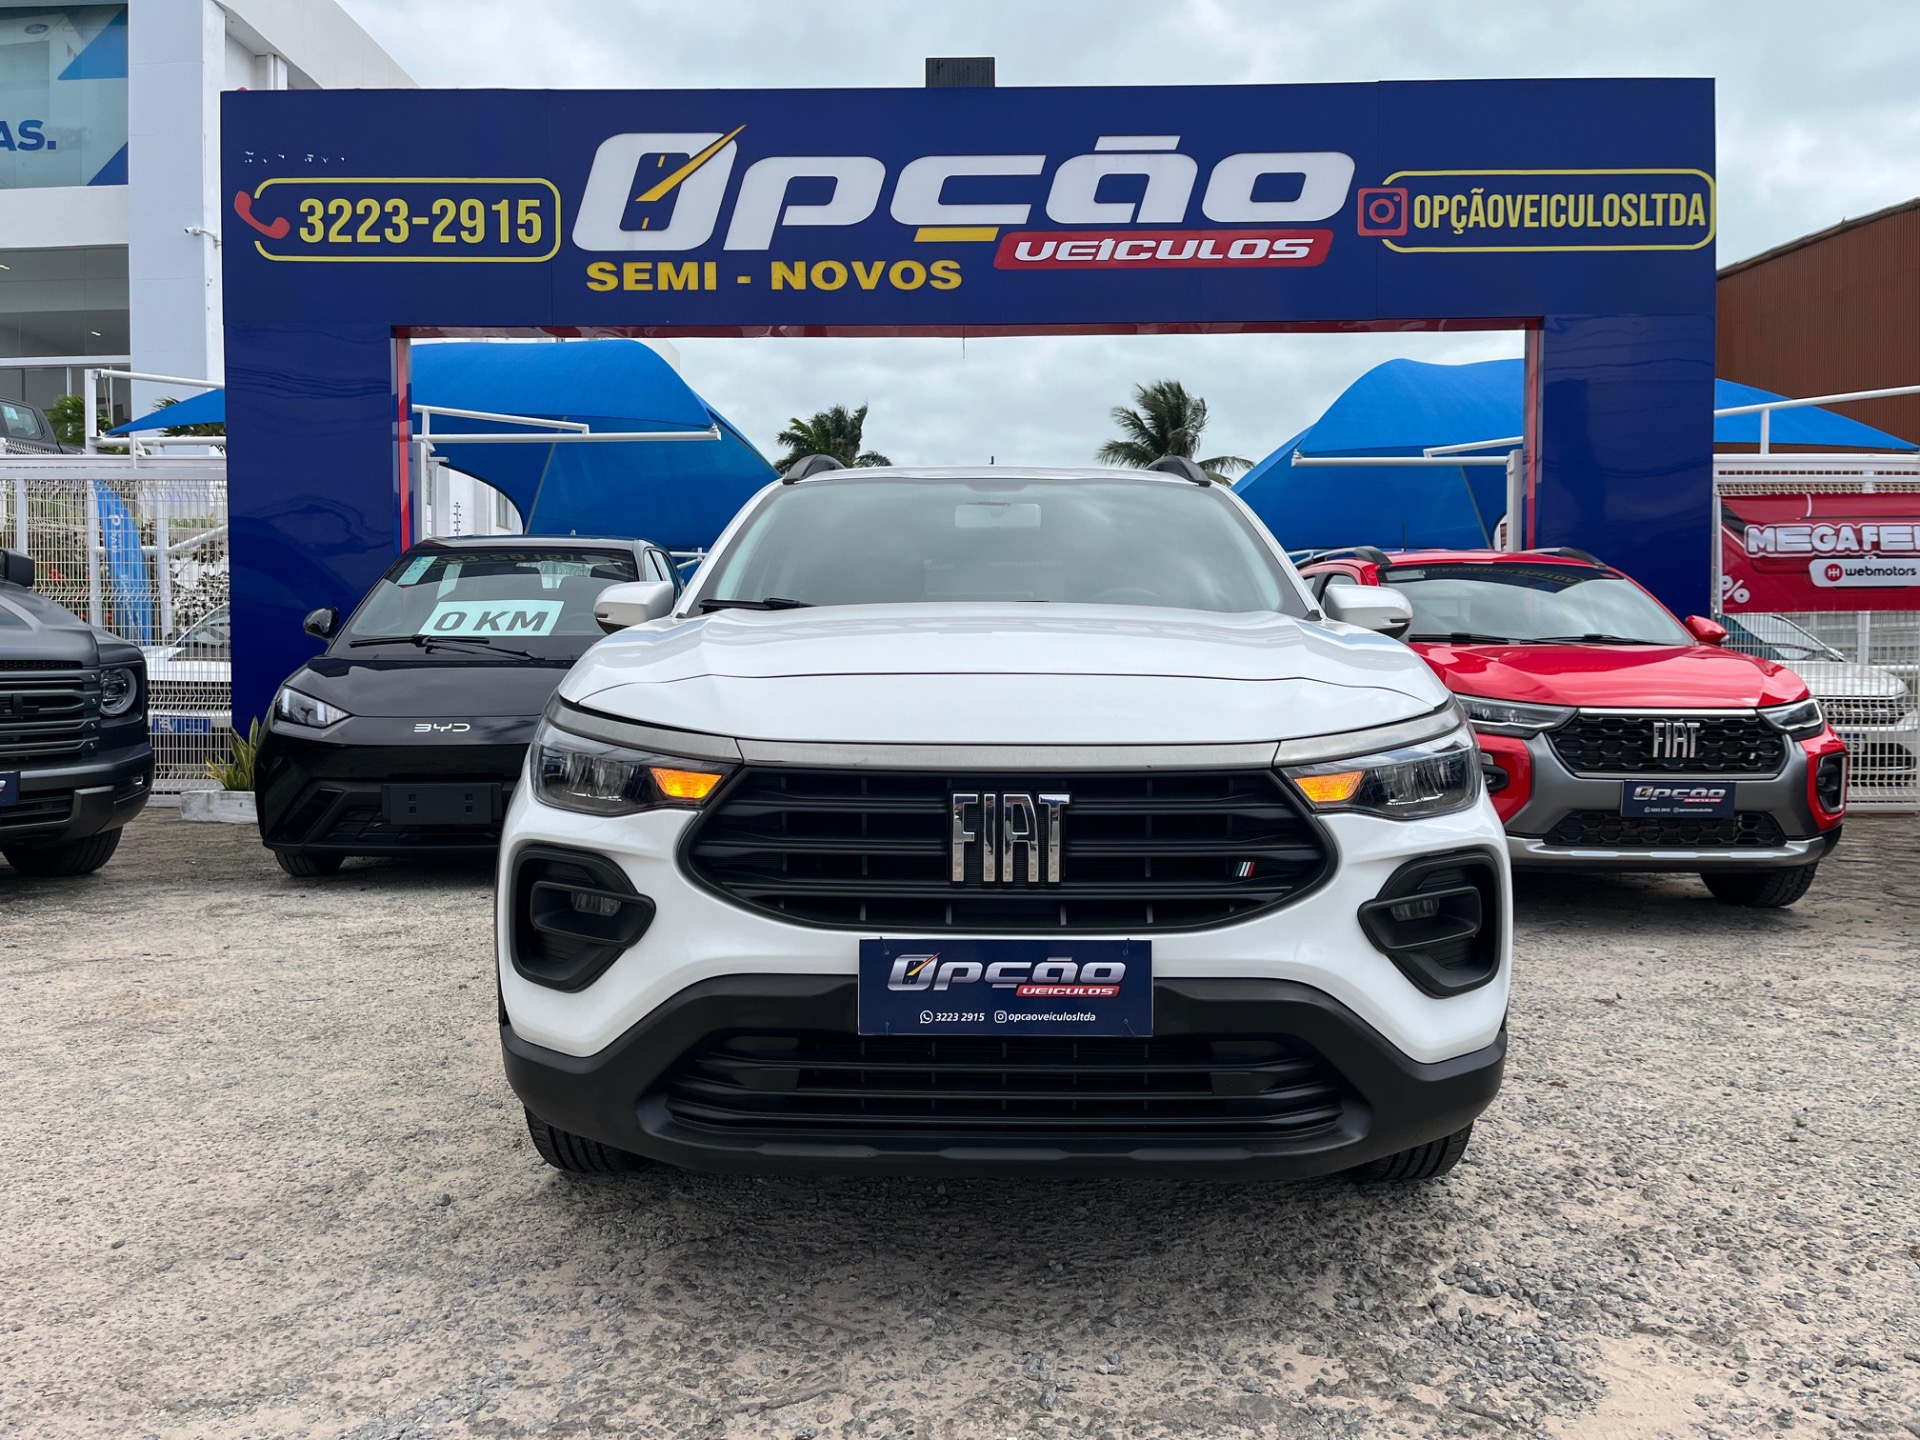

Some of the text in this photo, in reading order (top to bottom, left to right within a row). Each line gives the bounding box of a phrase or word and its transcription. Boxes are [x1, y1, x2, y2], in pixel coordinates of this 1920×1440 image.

[299, 198, 543, 244] 3223-2915
[1413, 187, 1707, 234] OPÇÃOVEICULOSLTDA
[586, 261, 717, 292] SEMI
[771, 260, 963, 291] NOVOS
[1748, 526, 1920, 552] MEGAFE
[1844, 565, 1917, 577] webmotors
[433, 611, 549, 632] 0 KM
[413, 723, 471, 733] BYD
[1652, 722, 1700, 758] FIAT
[951, 792, 1070, 883] FIAT
[935, 1012, 1096, 1023] 3223 2915 opcaoveiculosltda
